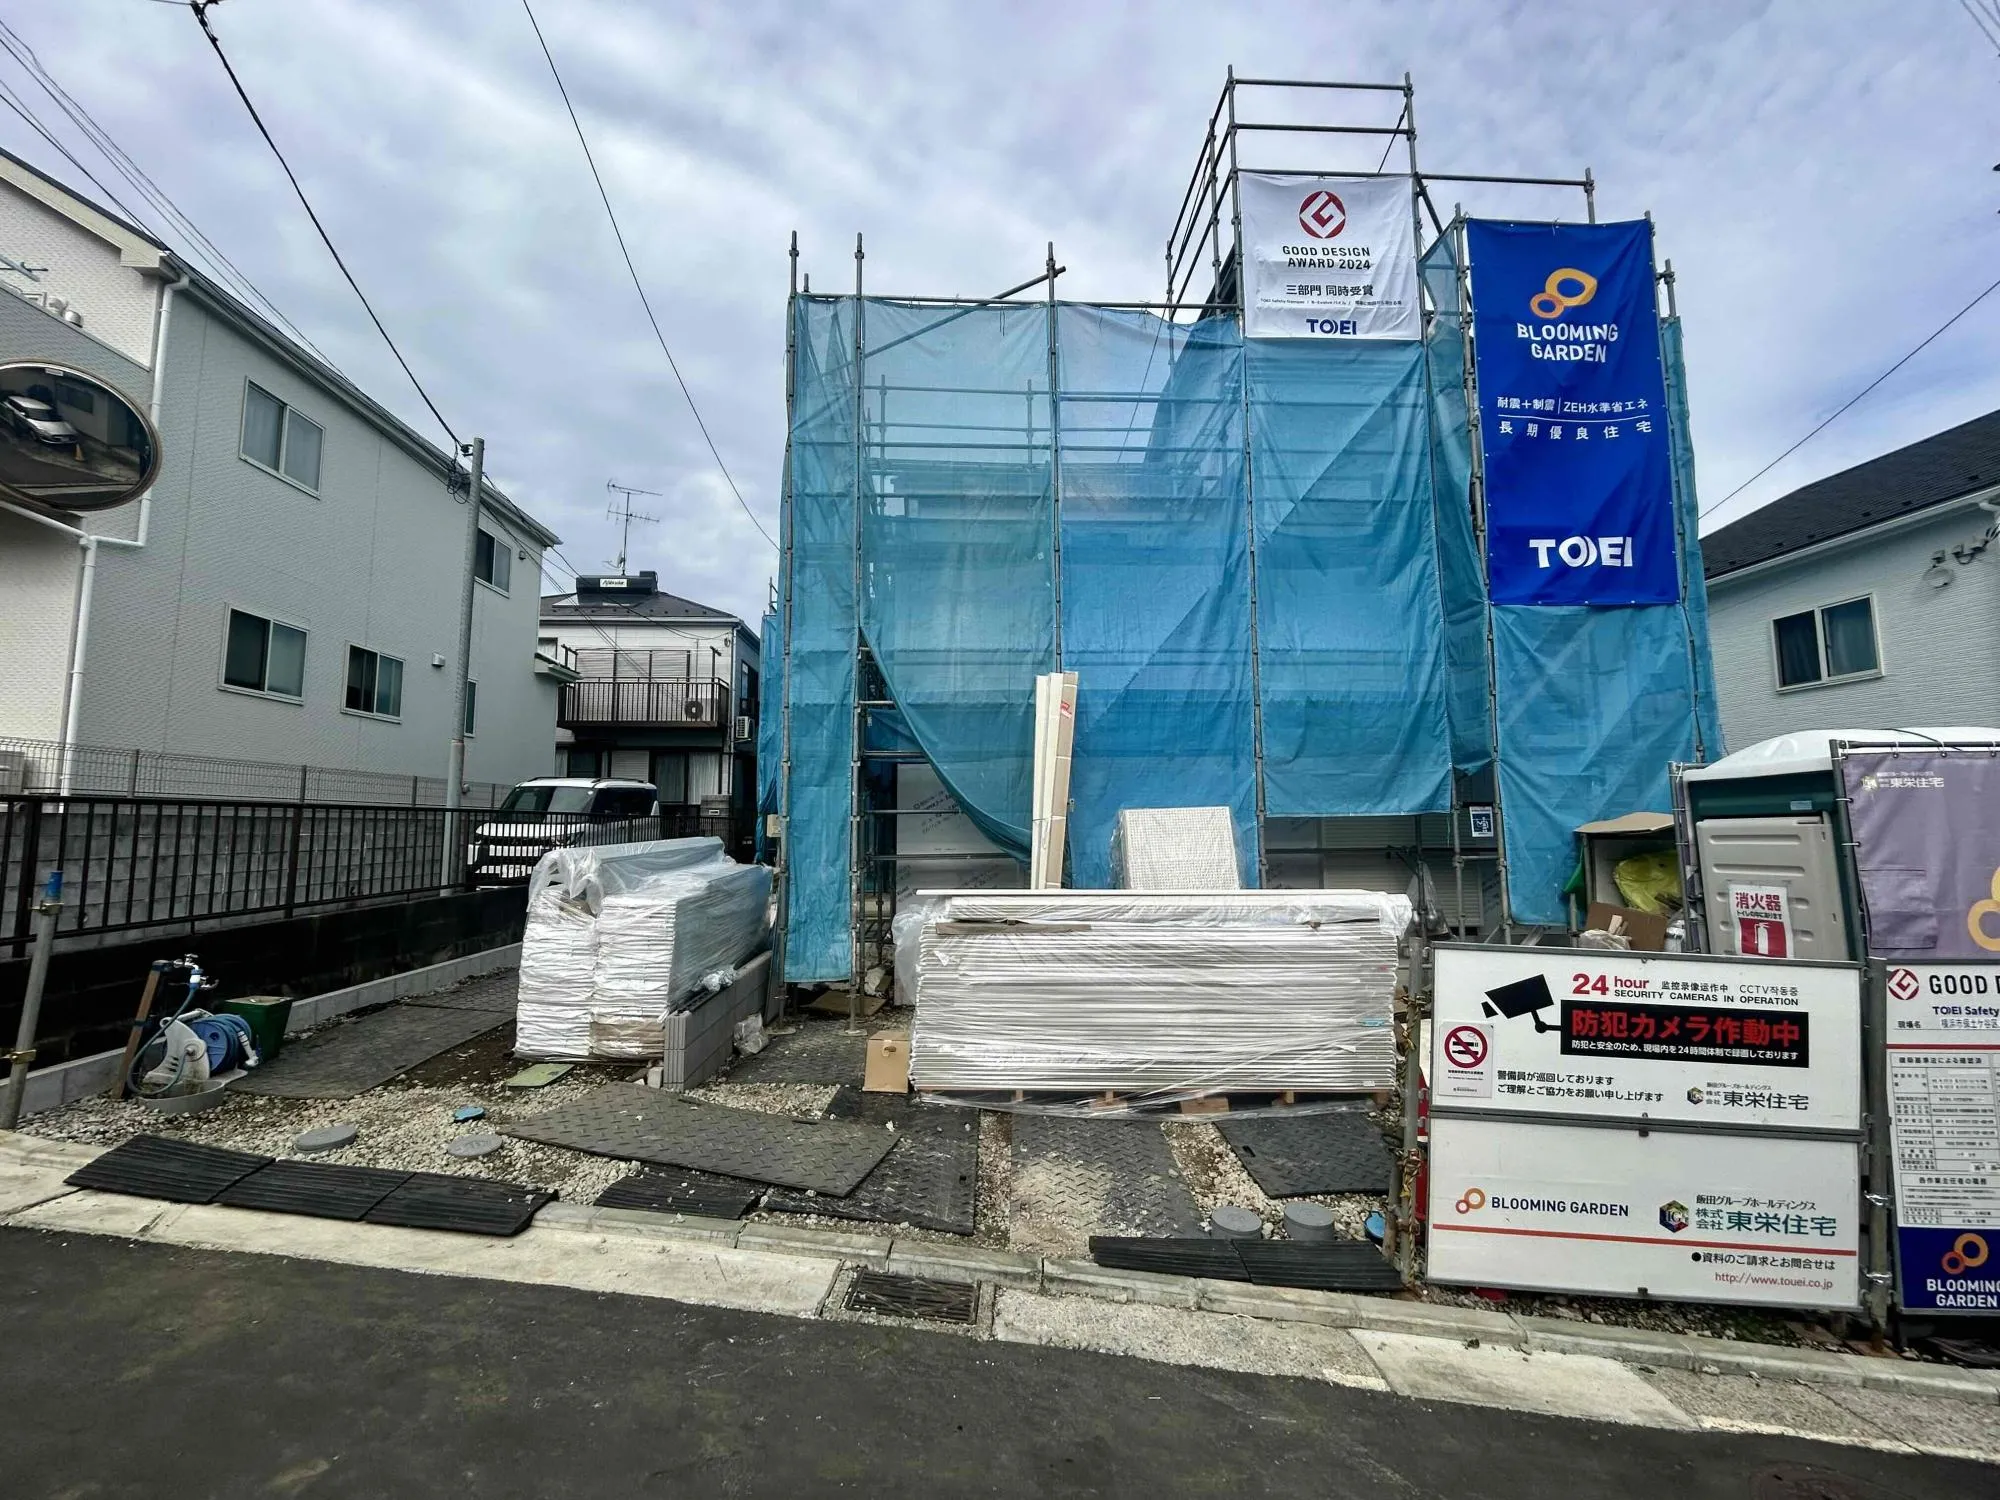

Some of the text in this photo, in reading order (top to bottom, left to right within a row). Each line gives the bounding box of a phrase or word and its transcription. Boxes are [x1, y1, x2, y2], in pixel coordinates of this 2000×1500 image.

[1283, 246, 1370, 256] GOOD DESIGN
[1288, 258, 1371, 270] AWARD 2024
[1286, 285, 1373, 296] 三部門 同時受賞
[1306, 319, 1357, 335] TOEI
[1517, 323, 1619, 341] BLOOMING
[1531, 344, 1607, 363] GARDEN
[1529, 536, 1633, 568] TOEI
[1736, 892, 1781, 911] 消火器
[1572, 973, 1609, 996] 24
[1614, 976, 1649, 989] hour
[1929, 975, 1988, 995] GOOD
[1614, 990, 1799, 1006] SECURITY CAMERAS IN OPERATION
[1965, 1006, 1999, 1017] Safety
[1571, 1009, 1800, 1047] 防犯カメラ作動中
[1497, 1070, 1614, 1086] 警備員が巡回しております
[1497, 1084, 1664, 1102] ご理解とご協力をお願い申し上げます
[1722, 1090, 1809, 1110] 東栄住宅
[1491, 1197, 1629, 1217] BLOOMING GARDEN
[1696, 1194, 1816, 1212] 飯田グループホールディングス
[1695, 1207, 1724, 1220] 株式
[1695, 1219, 1724, 1231] 会社
[1726, 1210, 1837, 1237] 東栄住宅
[1715, 1272, 1833, 1290] http://www.touei.co.jp
[1936, 1294, 1998, 1308] GARDEN
